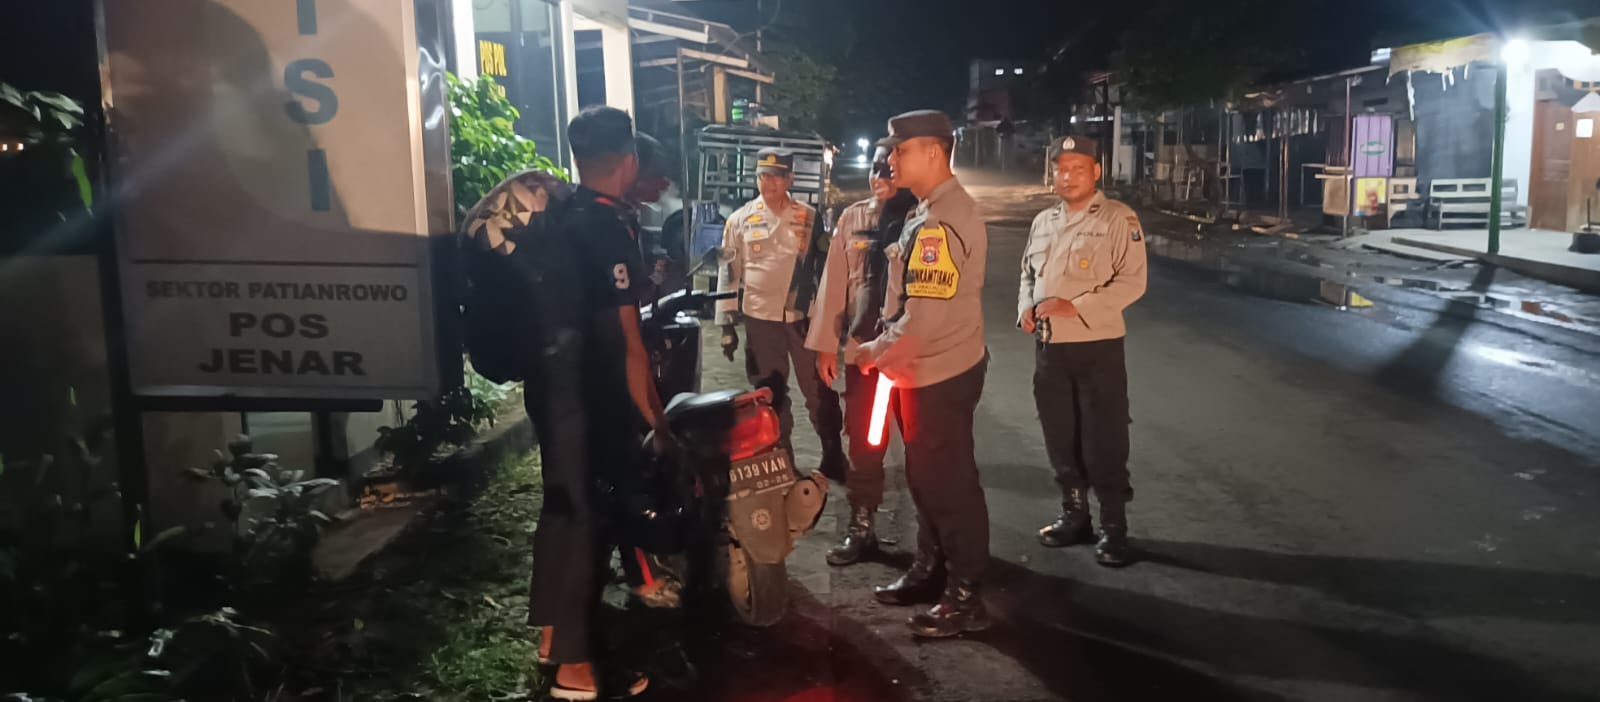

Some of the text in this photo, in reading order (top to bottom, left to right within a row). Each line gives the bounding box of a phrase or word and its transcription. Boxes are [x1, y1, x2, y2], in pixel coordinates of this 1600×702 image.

[613, 263, 630, 289] 9
[146, 280, 408, 302] SEKTOR PATIANROWO
[229, 312, 329, 339] POS
[197, 348, 367, 376] JENAR
[761, 457, 786, 474] VAN
